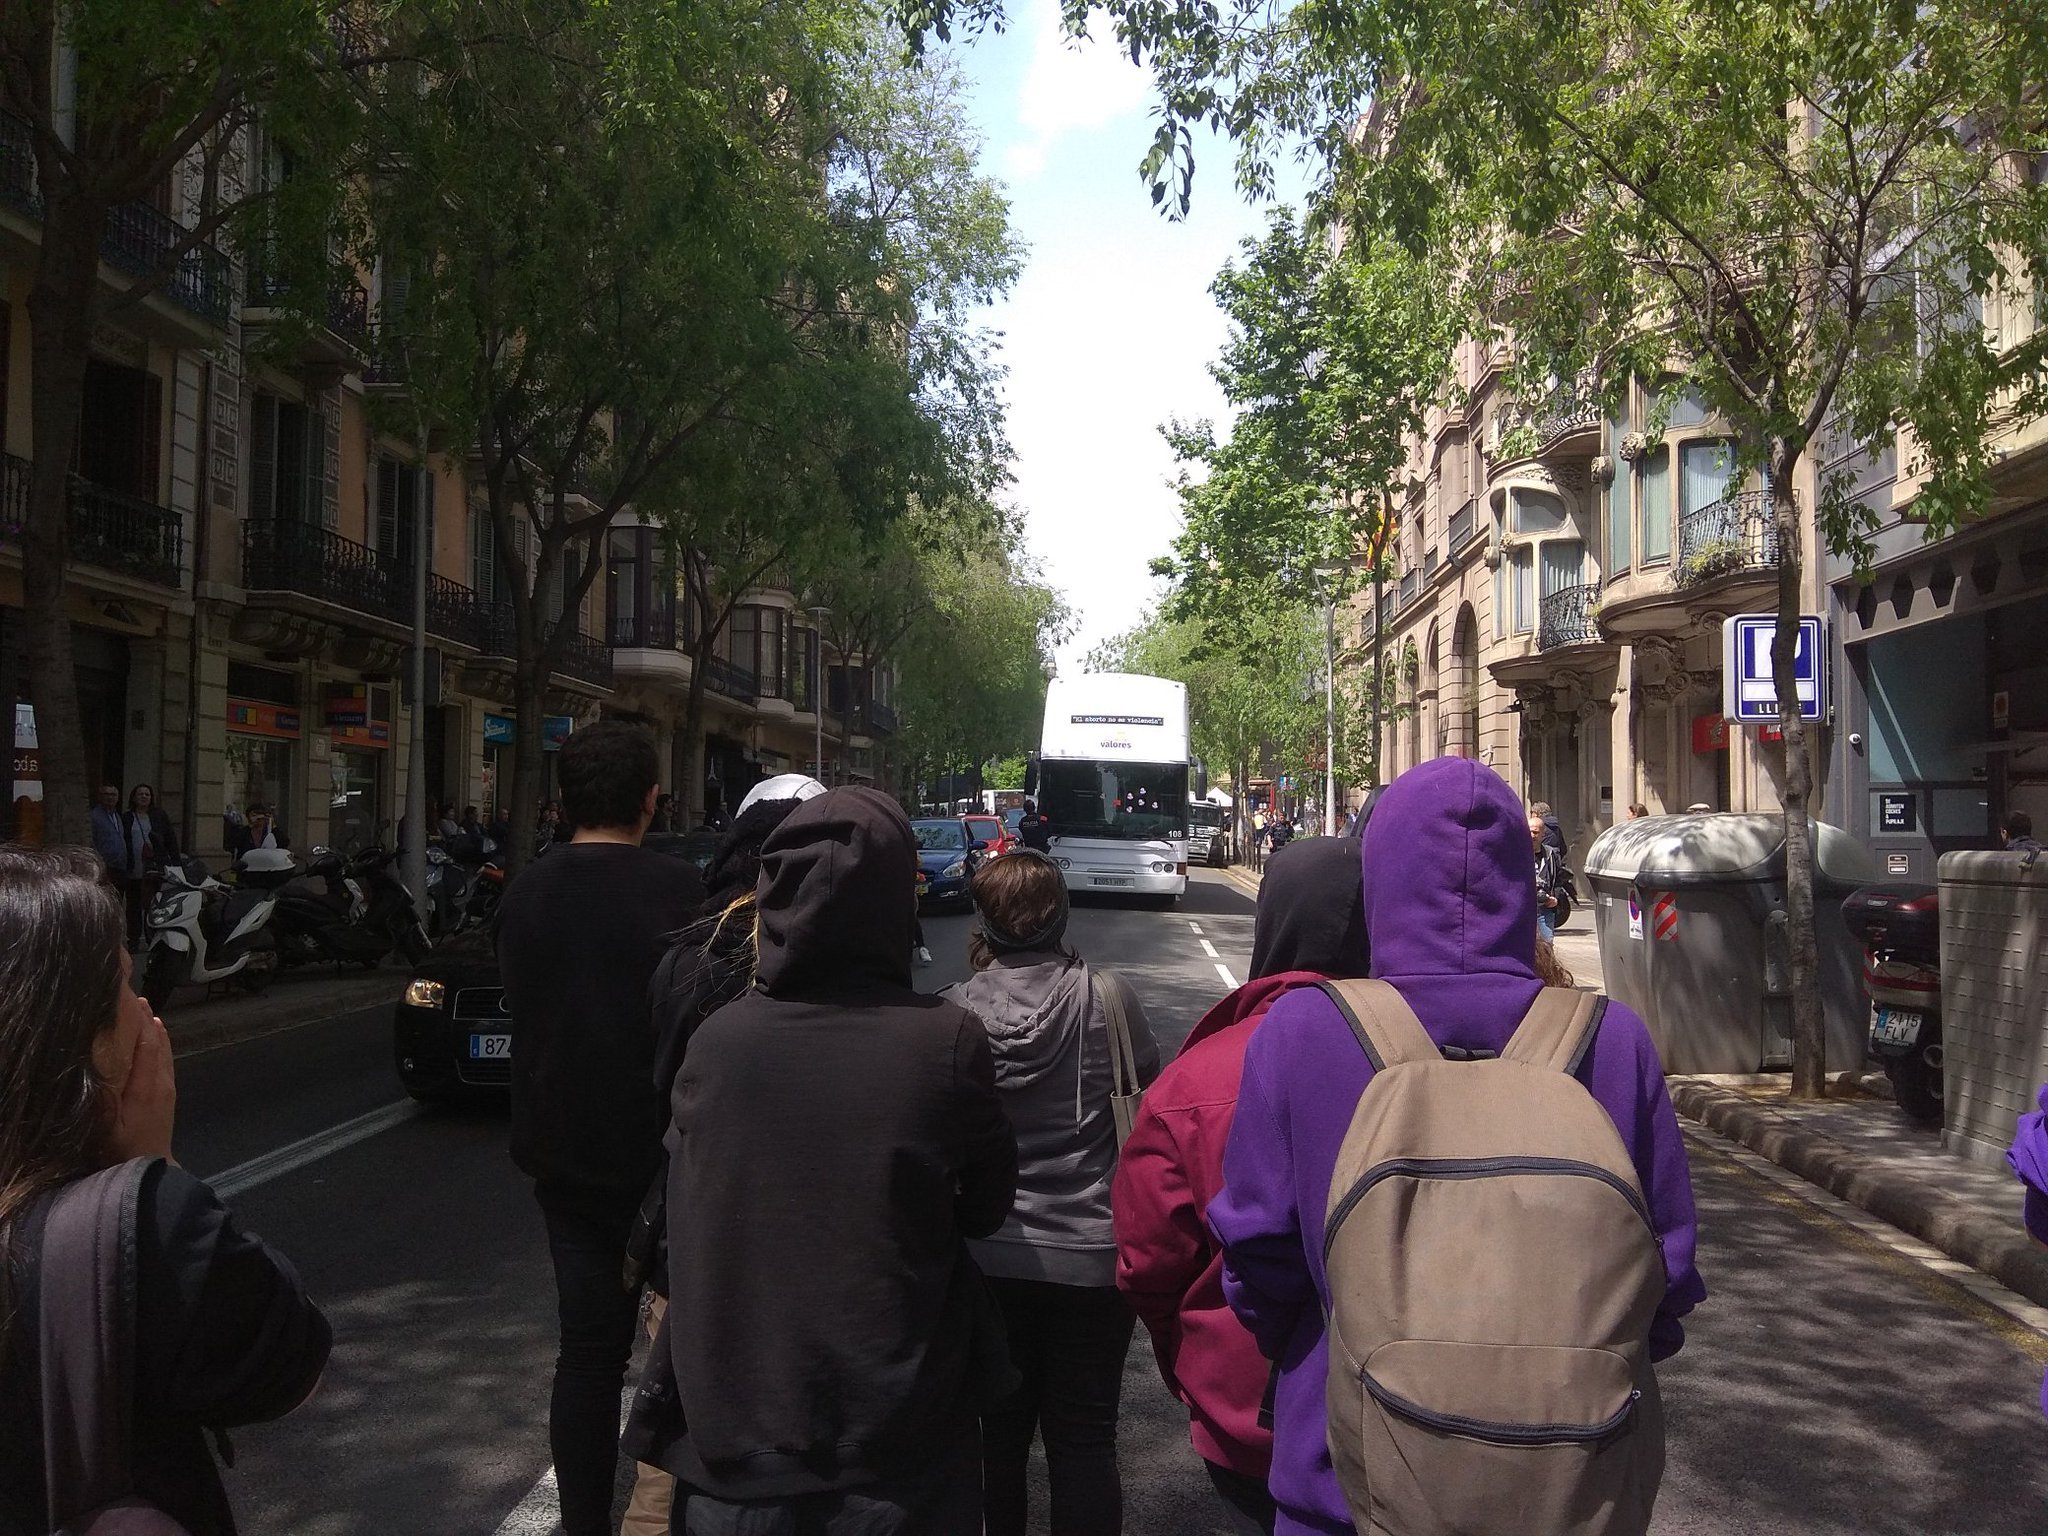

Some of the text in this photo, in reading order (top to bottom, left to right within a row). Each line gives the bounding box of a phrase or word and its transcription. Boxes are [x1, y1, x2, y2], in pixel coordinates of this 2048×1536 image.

[1100, 740, 1132, 749] valores
[1168, 830, 1183, 838] 108
[1888, 1012, 1920, 1028] 2115
[1884, 1025, 1909, 1041] FLV
